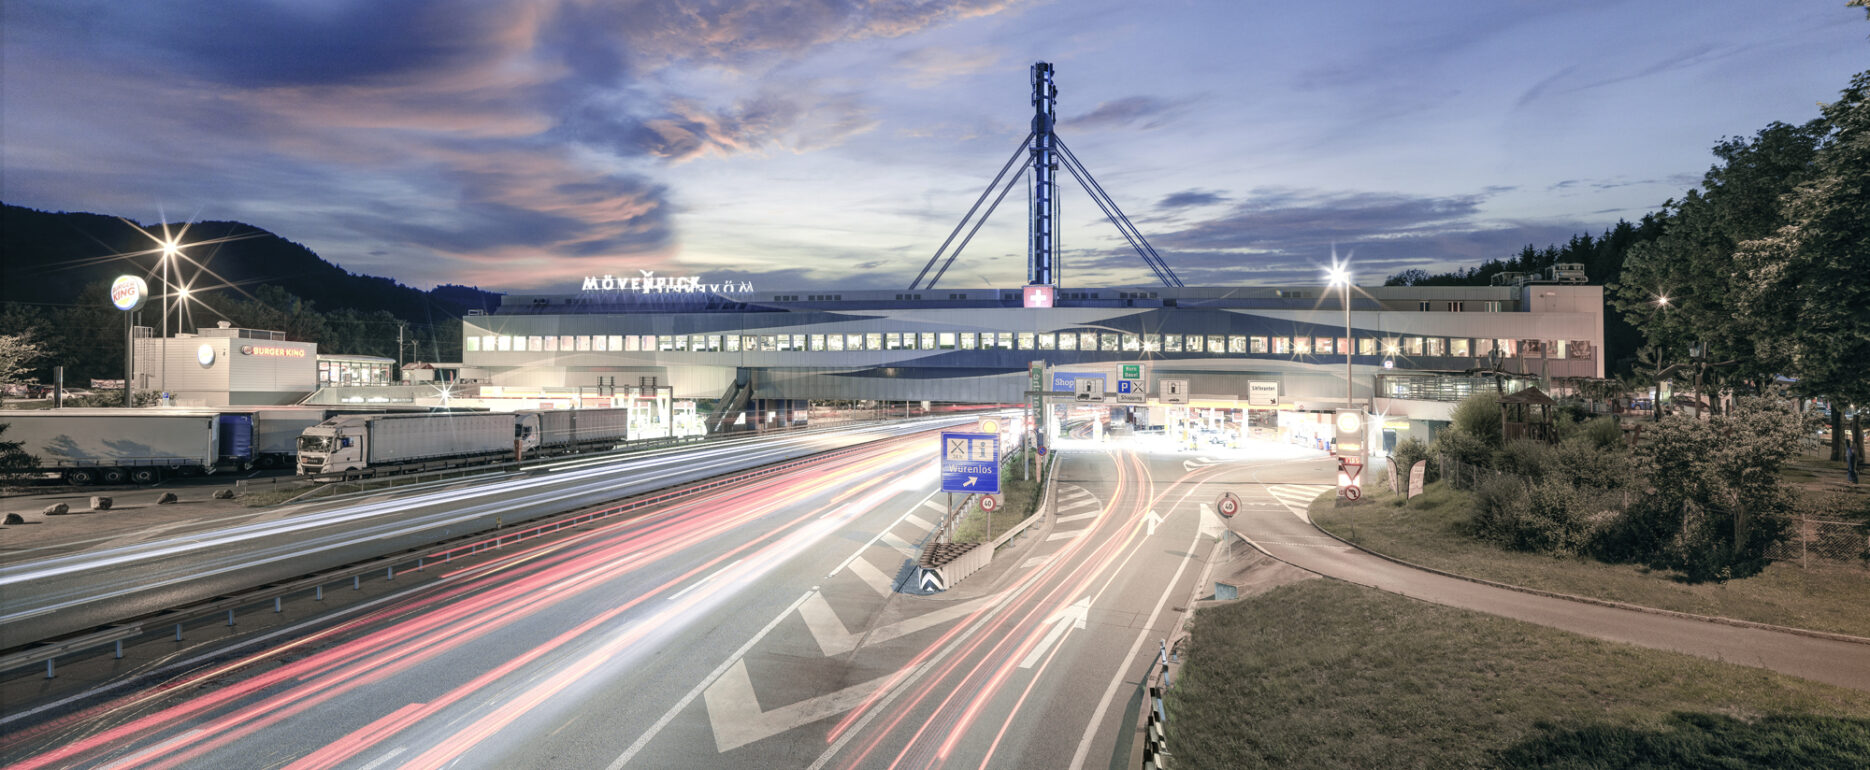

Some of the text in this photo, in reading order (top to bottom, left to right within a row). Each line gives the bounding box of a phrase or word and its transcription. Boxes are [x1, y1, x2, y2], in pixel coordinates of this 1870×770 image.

[582, 275, 700, 291] MÖVENPICK
[113, 287, 136, 302] KING
[253, 347, 285, 357] BURGER
[286, 349, 305, 358] KING
[1121, 382, 1128, 392] P
[949, 464, 992, 474] Würenlos
